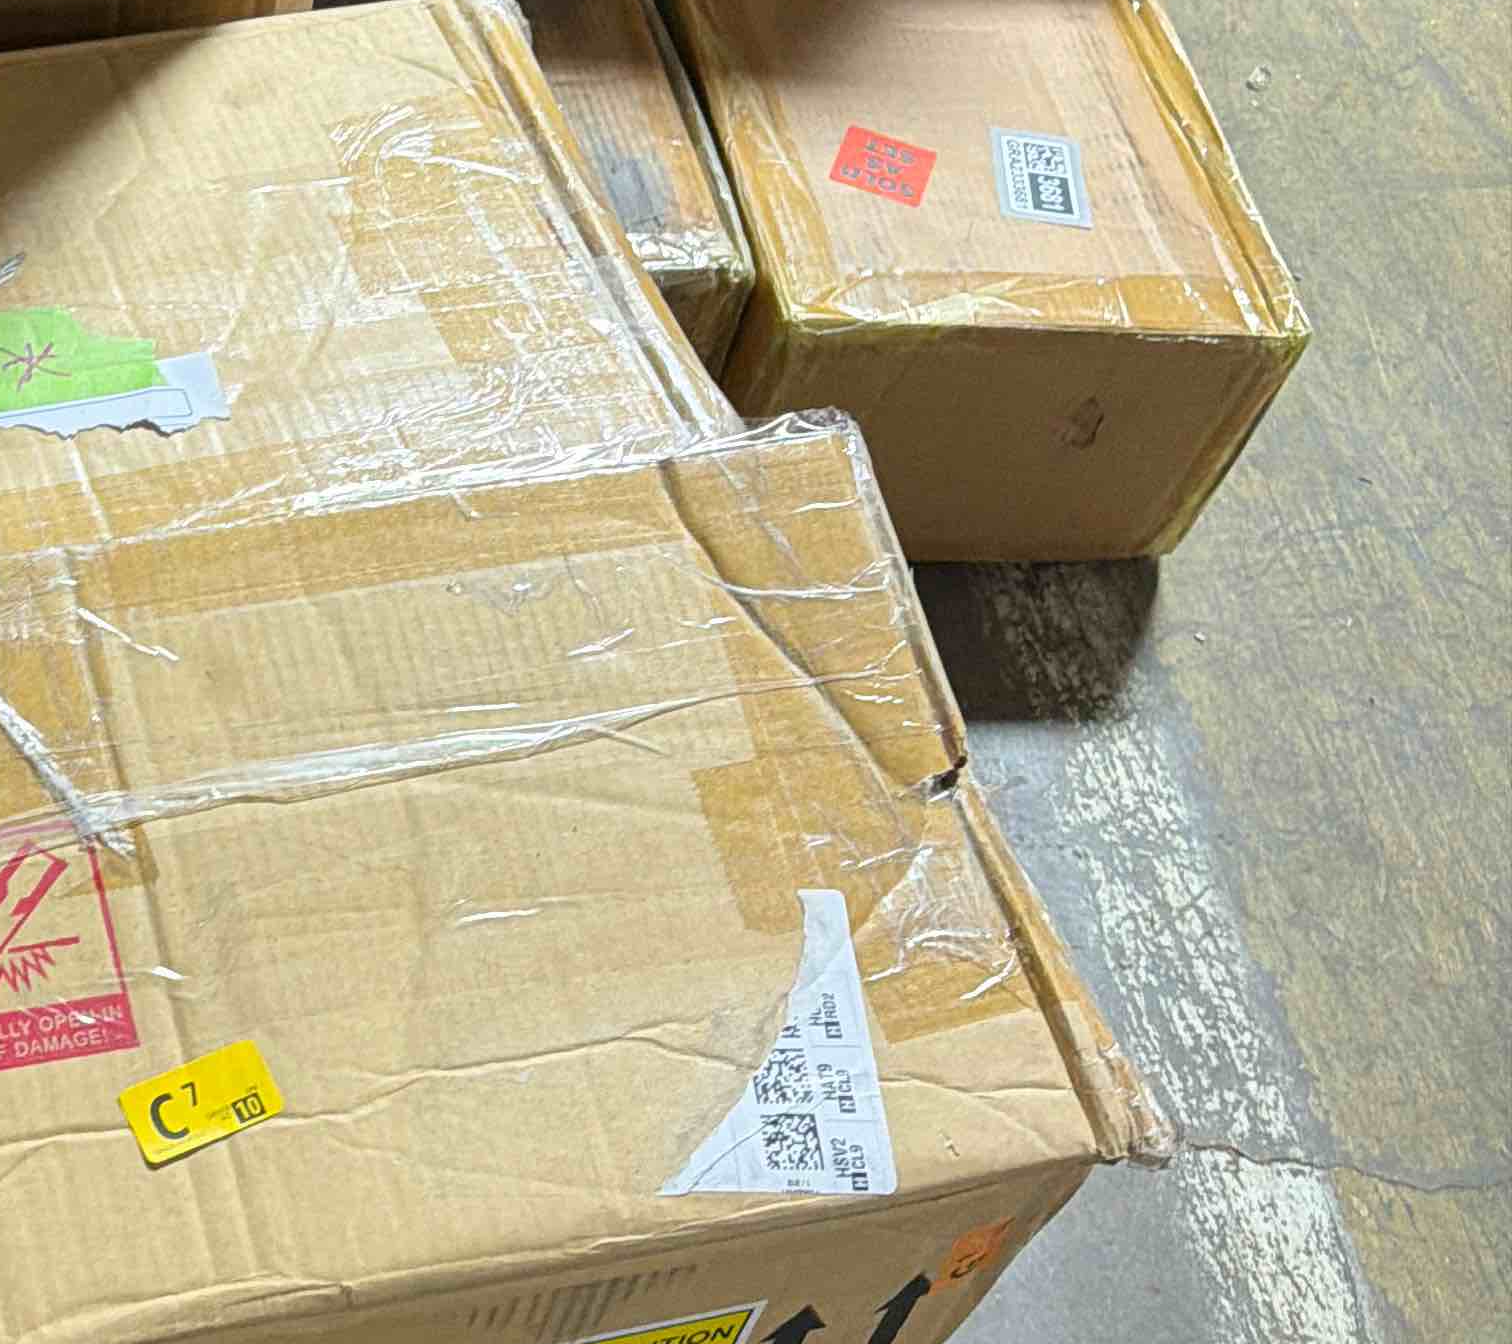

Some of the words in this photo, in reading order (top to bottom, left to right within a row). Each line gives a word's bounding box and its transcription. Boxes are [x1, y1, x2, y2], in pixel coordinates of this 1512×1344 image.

[1037, 175, 1066, 212] 3681
[13, 1027, 111, 1058] DAMAGE!
[816, 1062, 839, 1102] HAT9
[149, 1093, 190, 1141] C
[180, 1080, 199, 1107] 7
[234, 1093, 265, 1124] 10
[829, 1136, 852, 1179] HSV2
